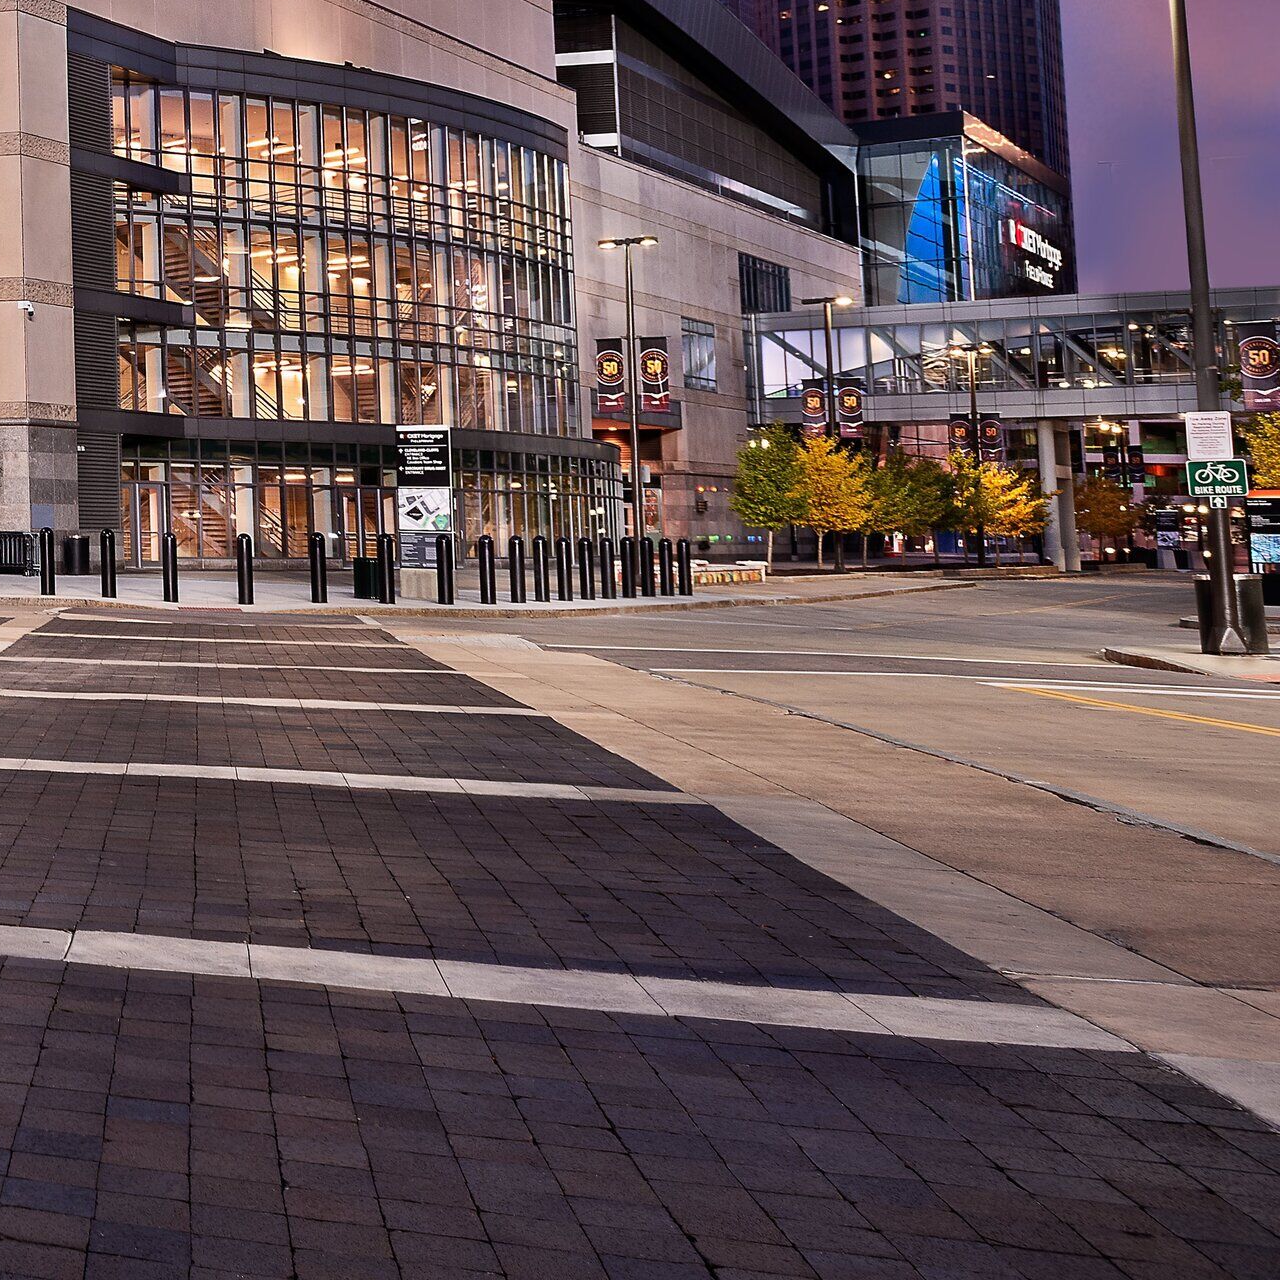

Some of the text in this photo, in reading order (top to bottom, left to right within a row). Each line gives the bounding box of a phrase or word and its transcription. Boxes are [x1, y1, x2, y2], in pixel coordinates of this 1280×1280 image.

[1248, 349, 1271, 366] 50
[602, 361, 618, 375] 50
[646, 360, 662, 374] 50
[807, 397, 820, 408] 50
[843, 396, 857, 407] 50
[986, 427, 997, 437] 50
[1194, 485, 1243, 494] BIKE ROUTE
